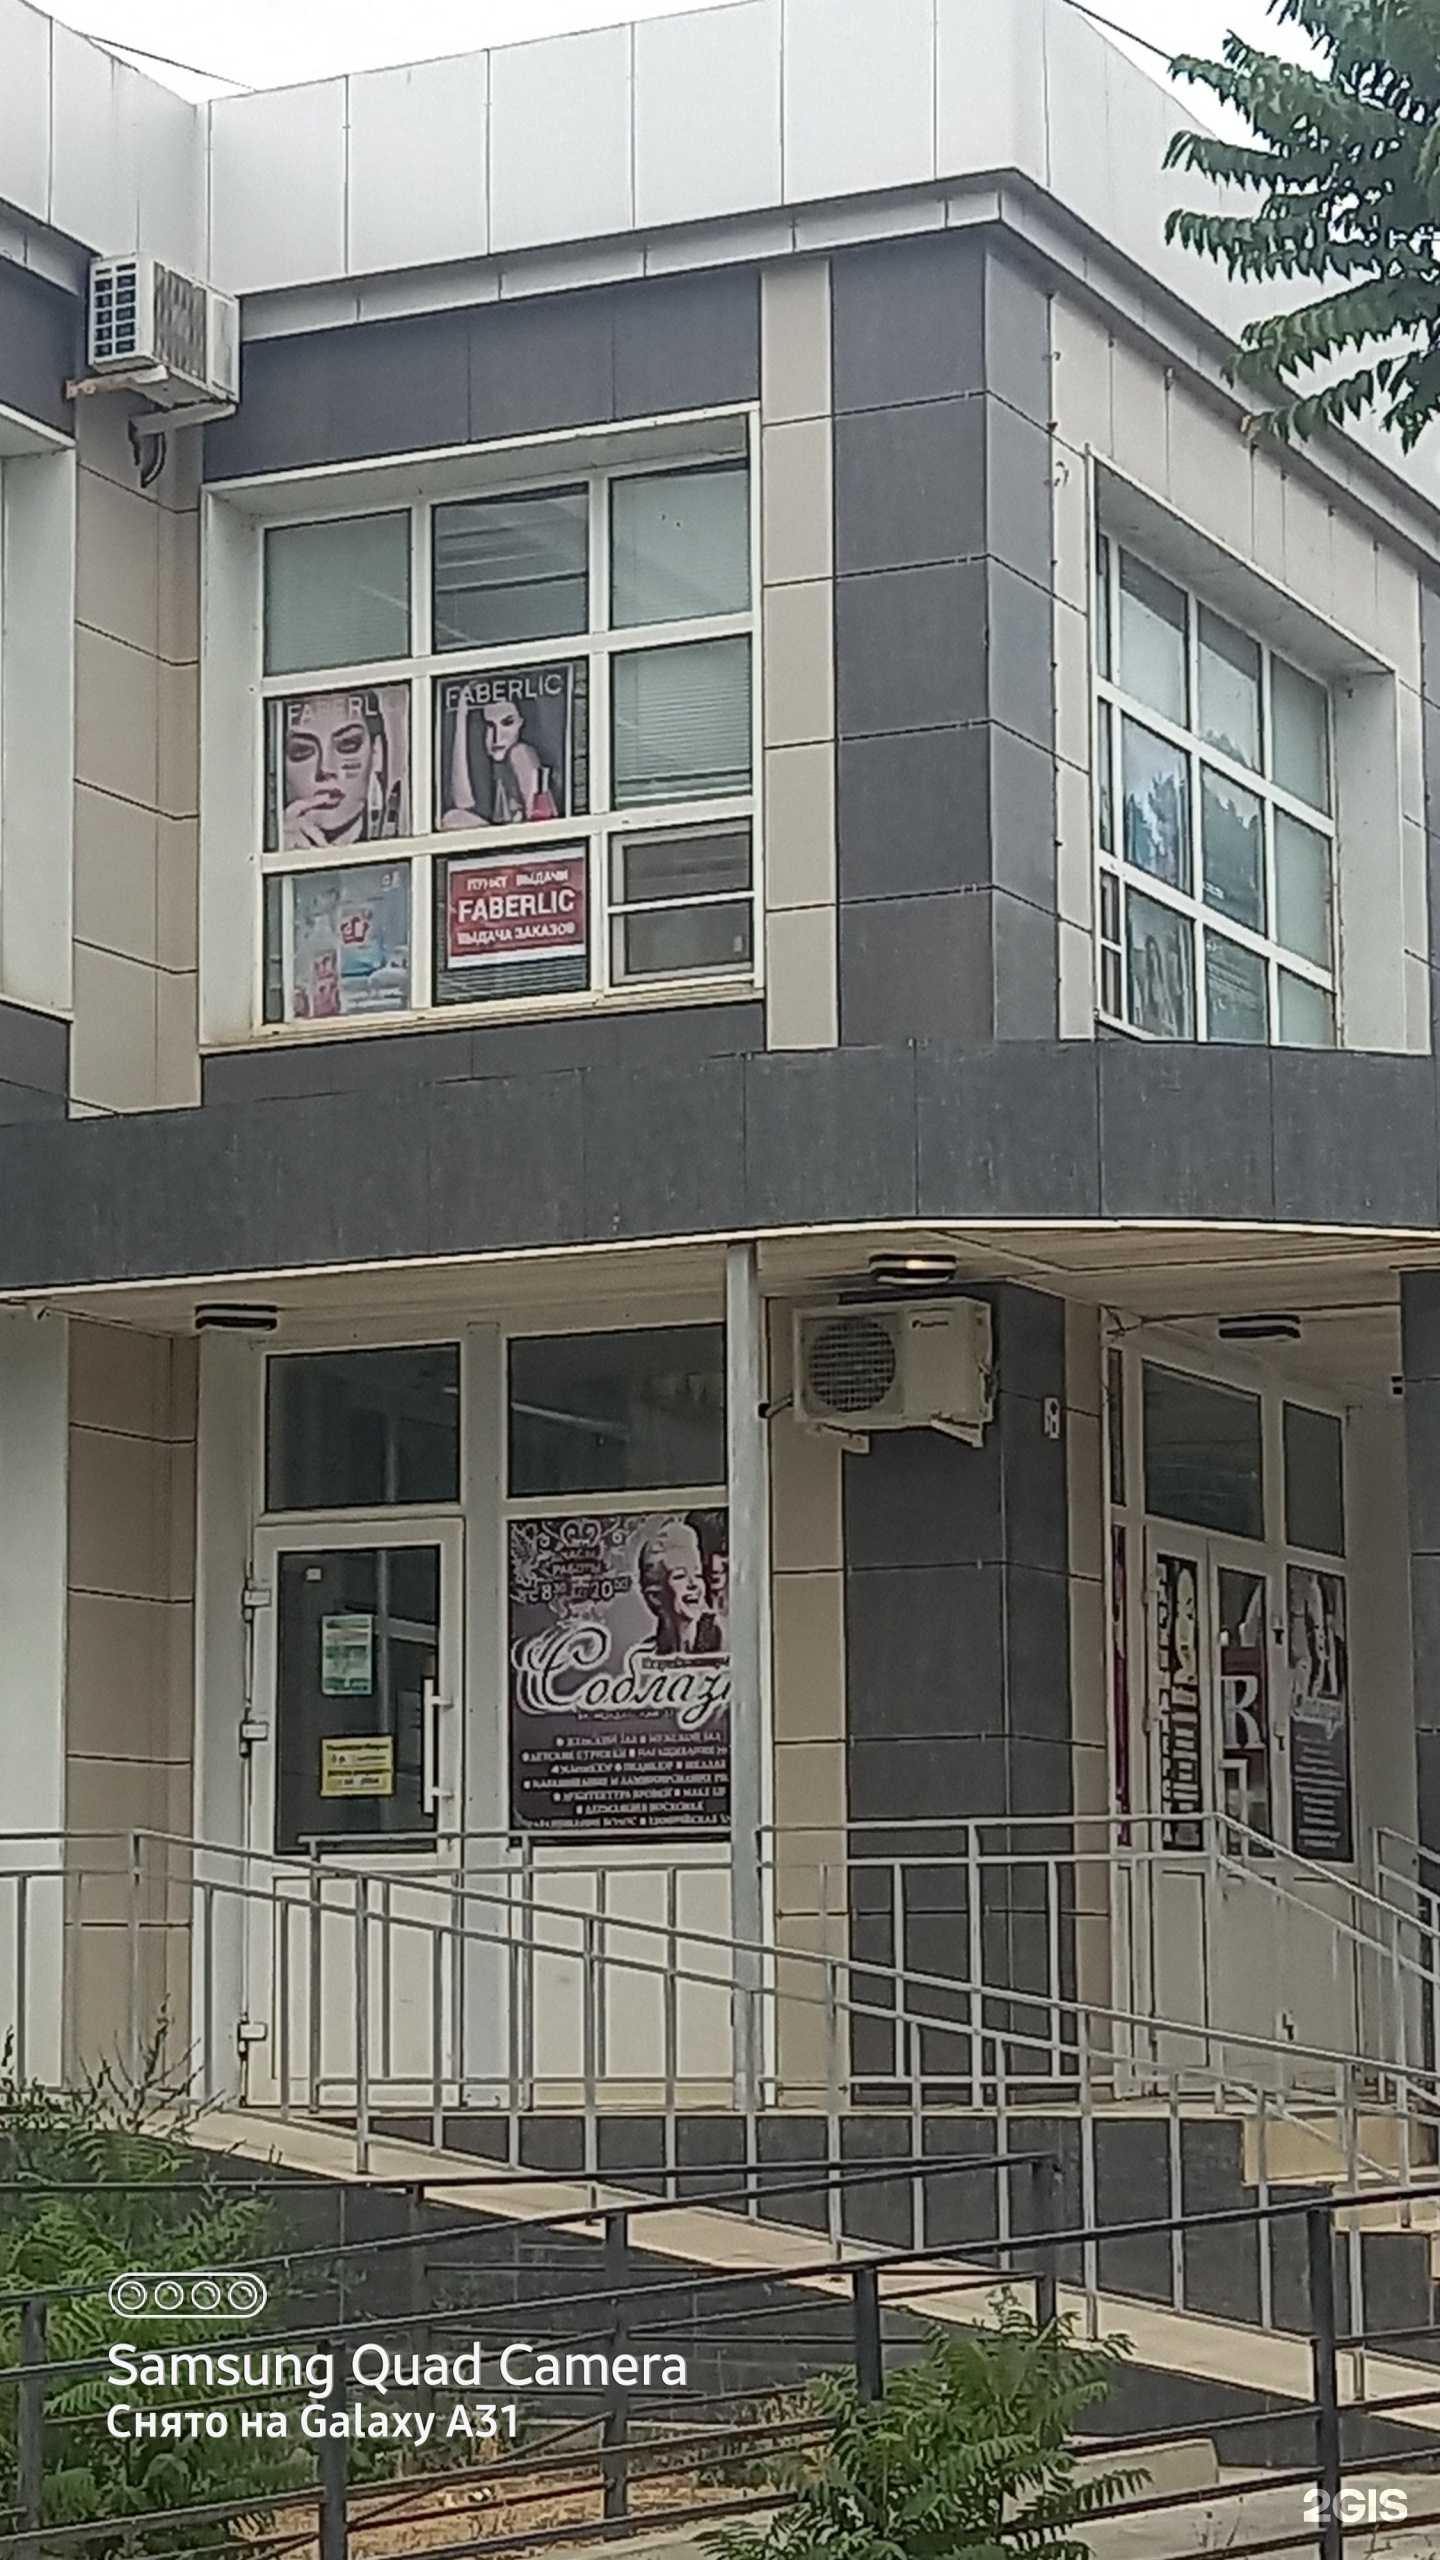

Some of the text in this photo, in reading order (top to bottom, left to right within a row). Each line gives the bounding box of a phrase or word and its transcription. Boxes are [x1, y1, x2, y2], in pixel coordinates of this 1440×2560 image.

[446, 673, 562, 708] FABERLIC
[458, 889, 576, 922] FABERLIC
[457, 922, 575, 945] ВЫДАЧА ЗАКАЗОВ
